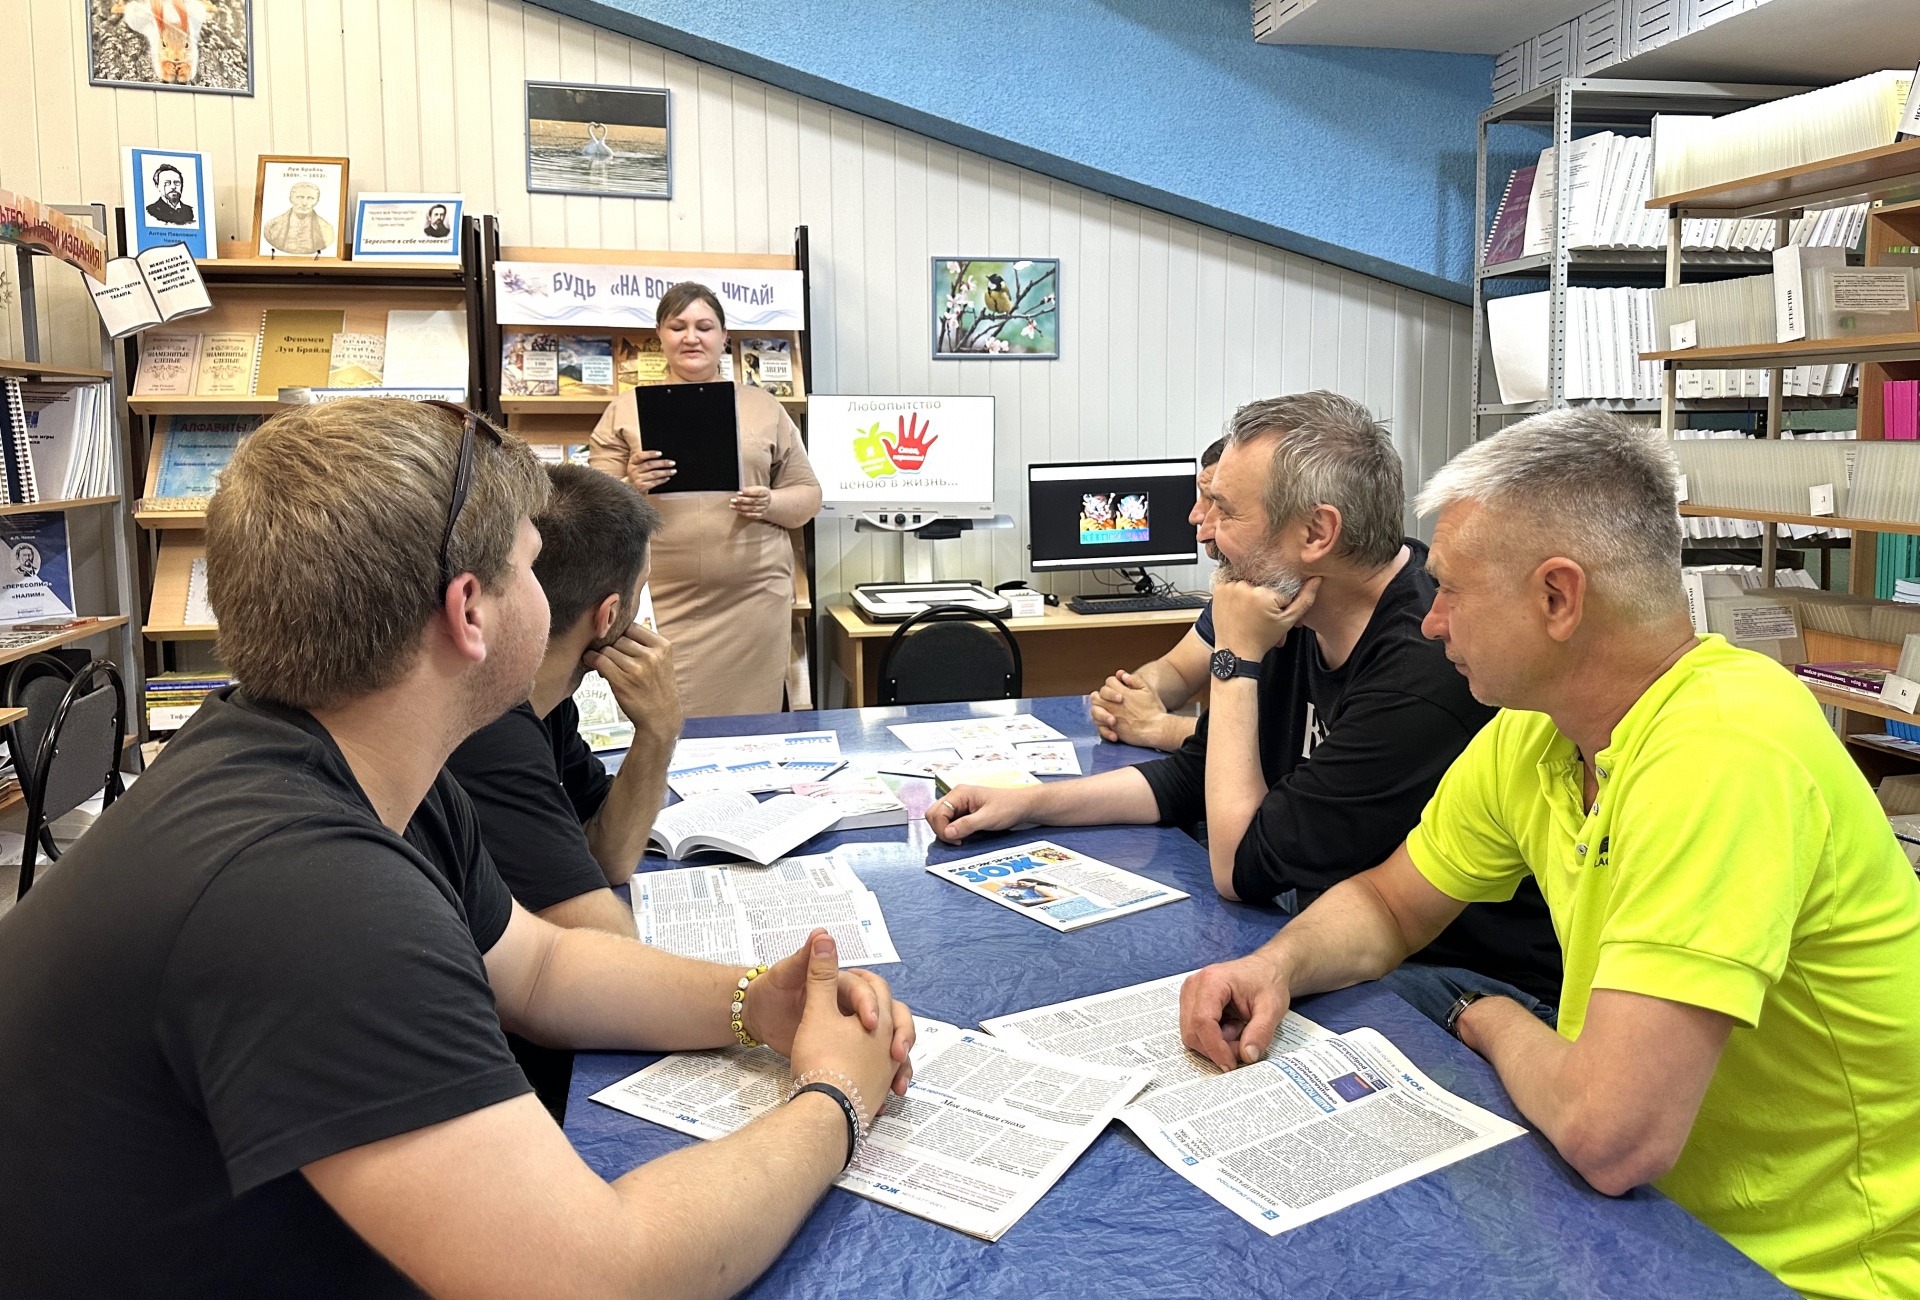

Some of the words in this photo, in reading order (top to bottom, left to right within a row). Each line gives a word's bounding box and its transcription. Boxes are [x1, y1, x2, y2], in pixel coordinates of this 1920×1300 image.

[61, 230, 102, 271] ИЗДАНИЯ!
[95, 286, 120, 298] КРАТКОСТЬ
[124, 280, 142, 290] СЕСТРА
[553, 272, 596, 301] БУДЬ
[610, 274, 641, 298] «НА
[722, 281, 774, 306] ЧИТАЙ!
[1787, 289, 1795, 331] ДЕТЕКТИВ
[284, 335, 324, 343] Феномен
[275, 346, 294, 354] Луи
[296, 346, 330, 354] Брайля
[765, 366, 787, 374] ЗВЕРИ
[848, 400, 942, 412] Любопытство
[180, 423, 248, 433] АЛФАВИТЫ
[840, 480, 886, 490] ценою
[892, 479, 898, 488] в
[1804, 669, 1817, 677] остров
[575, 689, 608, 701] ИЗНИ
[955, 857, 1048, 882] ЗОЖ
[1292, 1057, 1313, 1073] РОССИИ
[1283, 1066, 1317, 1096] ПОДПИСНЫЕ
[1296, 1066, 1338, 1104] ОФИЦИАЛЬНЫЙ
[1311, 1073, 1330, 1090] ПОЧТЫ
[1400, 1073, 1426, 1091] ЗОЖ
[1312, 1094, 1333, 1112] НАШИ
[941, 1100, 960, 1109] Моя
[960, 1106, 1000, 1122] любимая
[1000, 1119, 1026, 1129] сноха
[1173, 1132, 1186, 1143] ВСЕХ
[1183, 1142, 1202, 1158] ГРОМЧЕ
[873, 1182, 901, 1194] ЗОЖ
